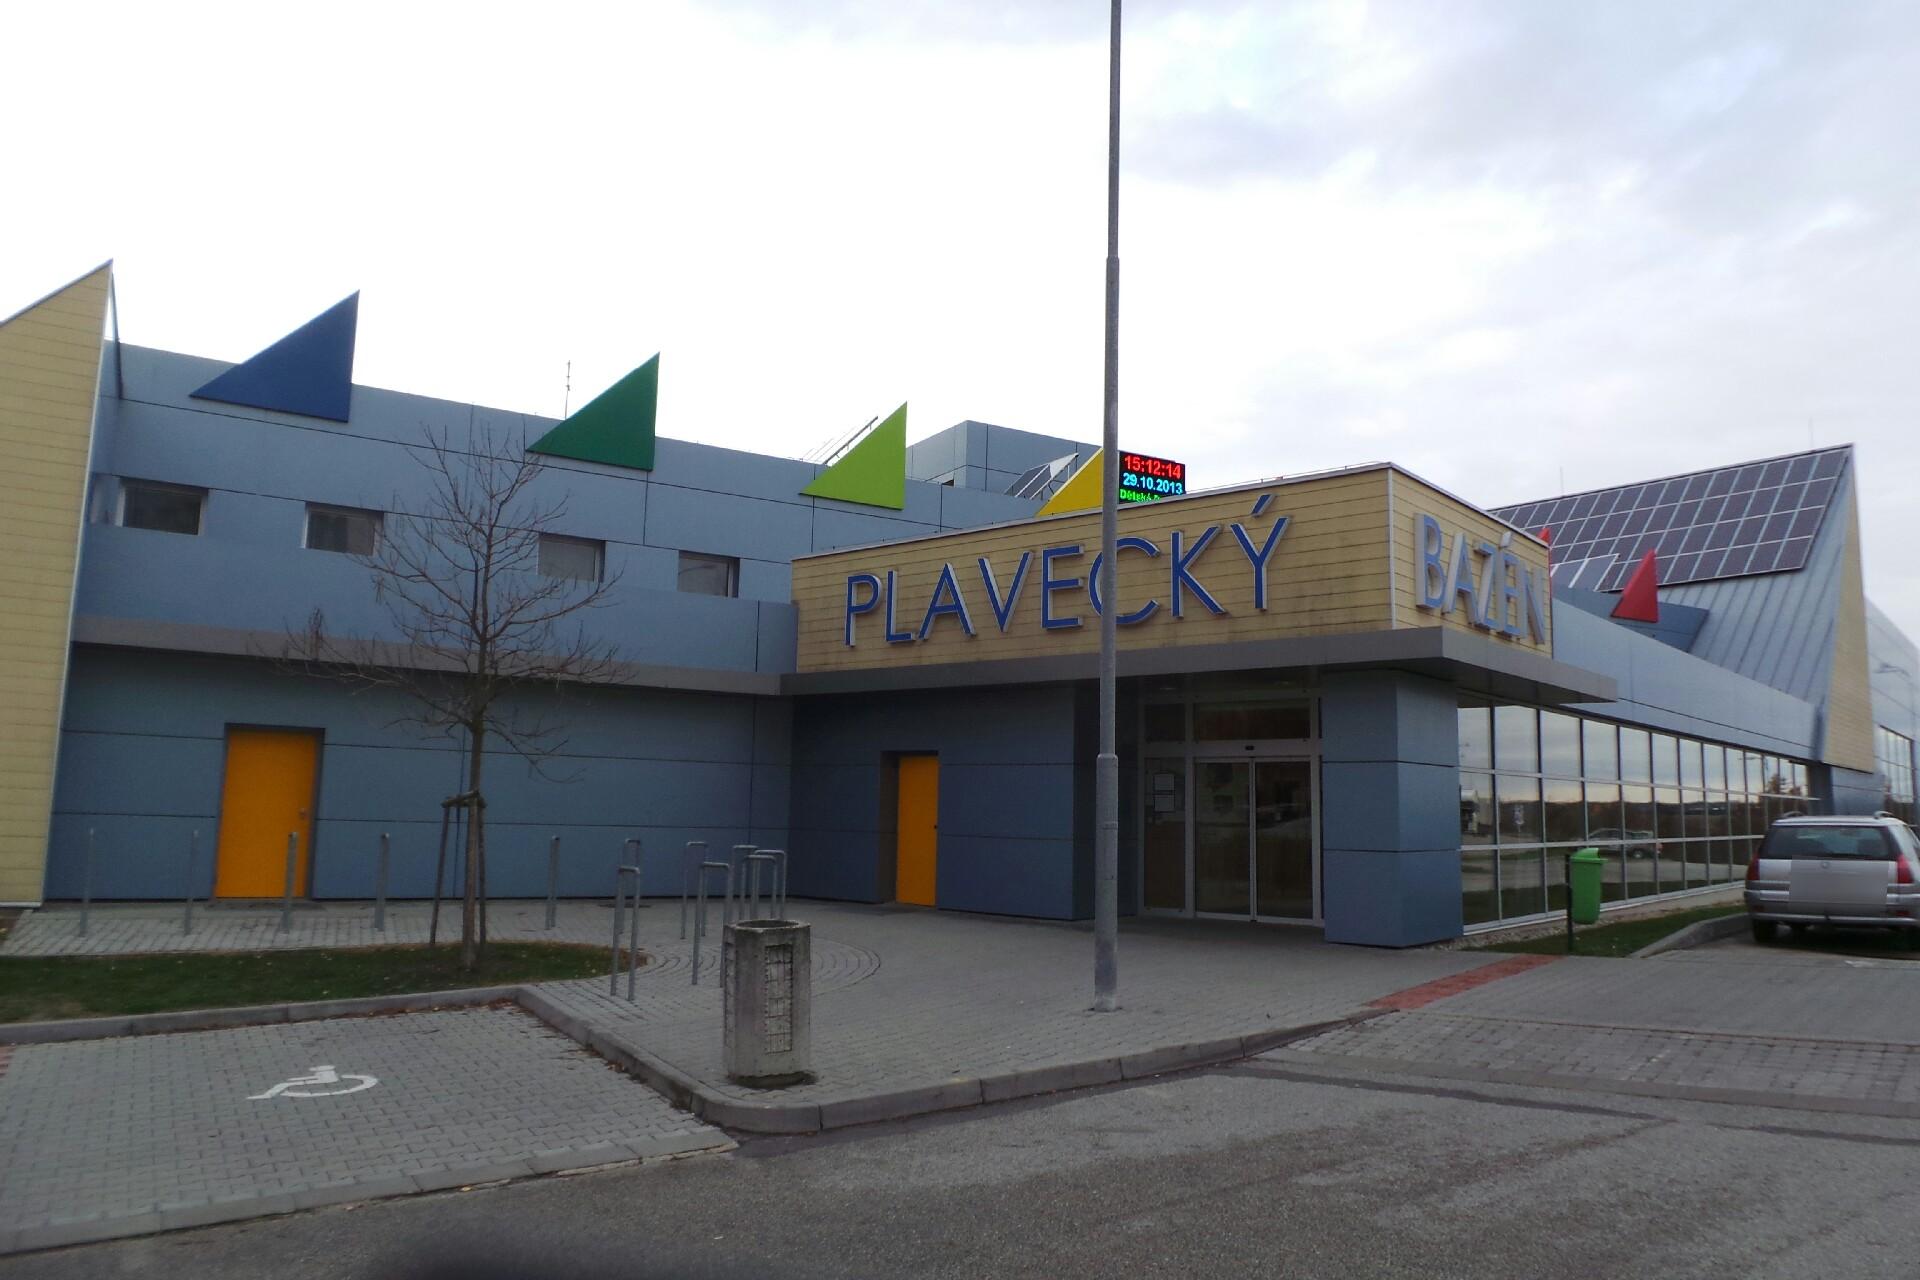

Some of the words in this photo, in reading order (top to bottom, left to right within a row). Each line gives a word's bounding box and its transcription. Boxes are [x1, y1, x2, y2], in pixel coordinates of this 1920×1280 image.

[1123, 472, 1183, 495] 29.10.2013
[1124, 455, 1181, 479] 15:12:14
[845, 493, 1291, 647] PLAVECKÝ
[1415, 513, 1545, 645] BAZÉN
